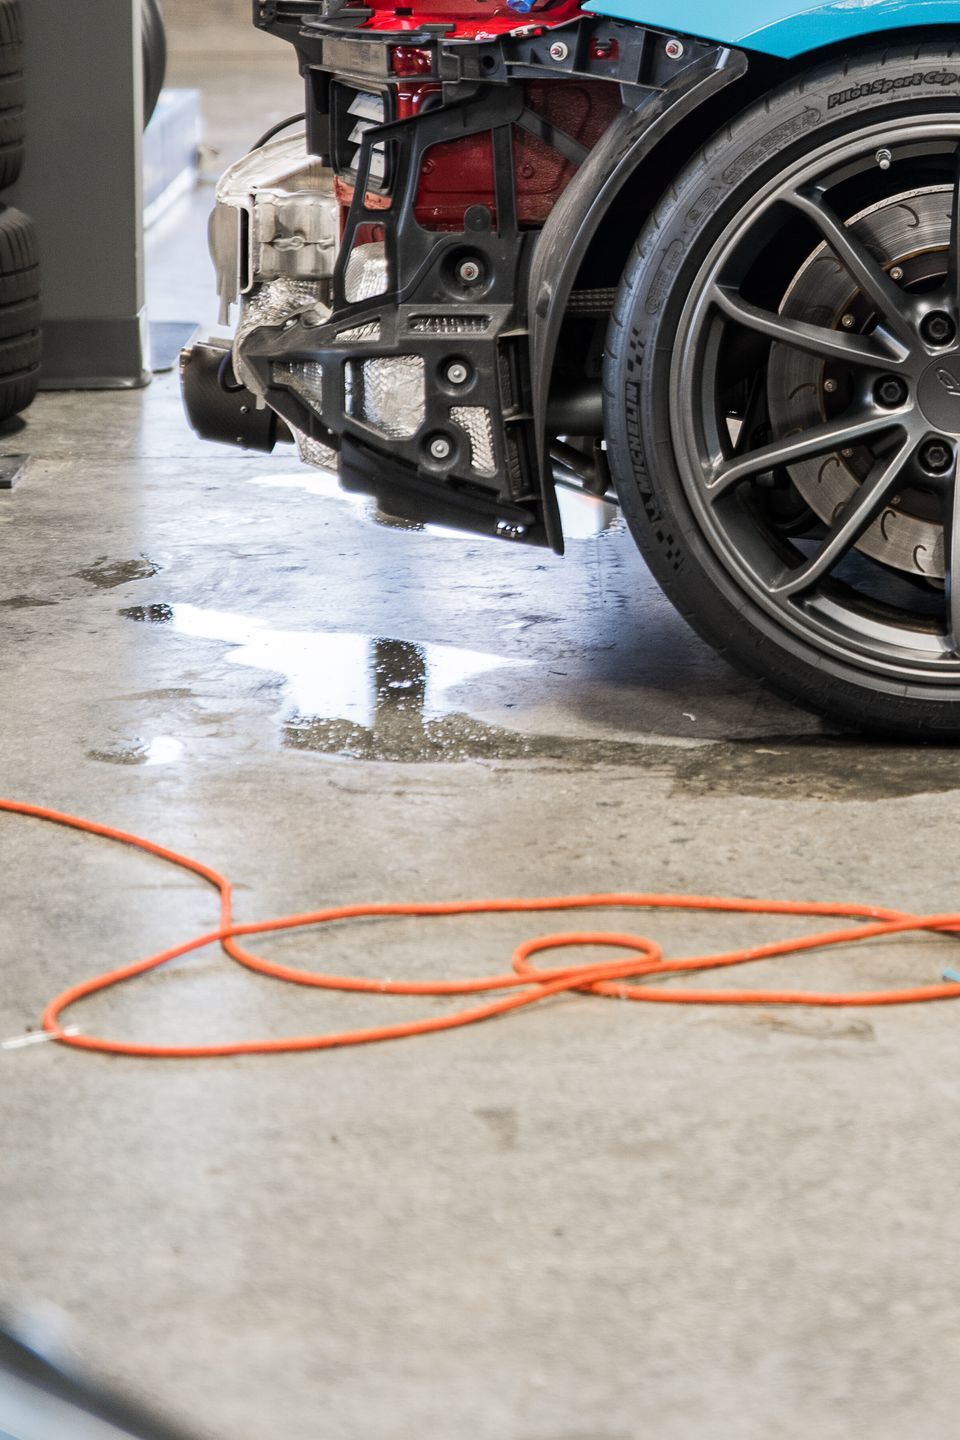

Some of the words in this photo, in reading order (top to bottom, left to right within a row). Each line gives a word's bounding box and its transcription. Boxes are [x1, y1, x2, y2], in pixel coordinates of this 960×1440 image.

[827, 83, 871, 110] Pilot
[871, 72, 923, 94] Sport
[923, 70, 958, 86] Cup
[625, 380, 652, 494] MICHELIN
